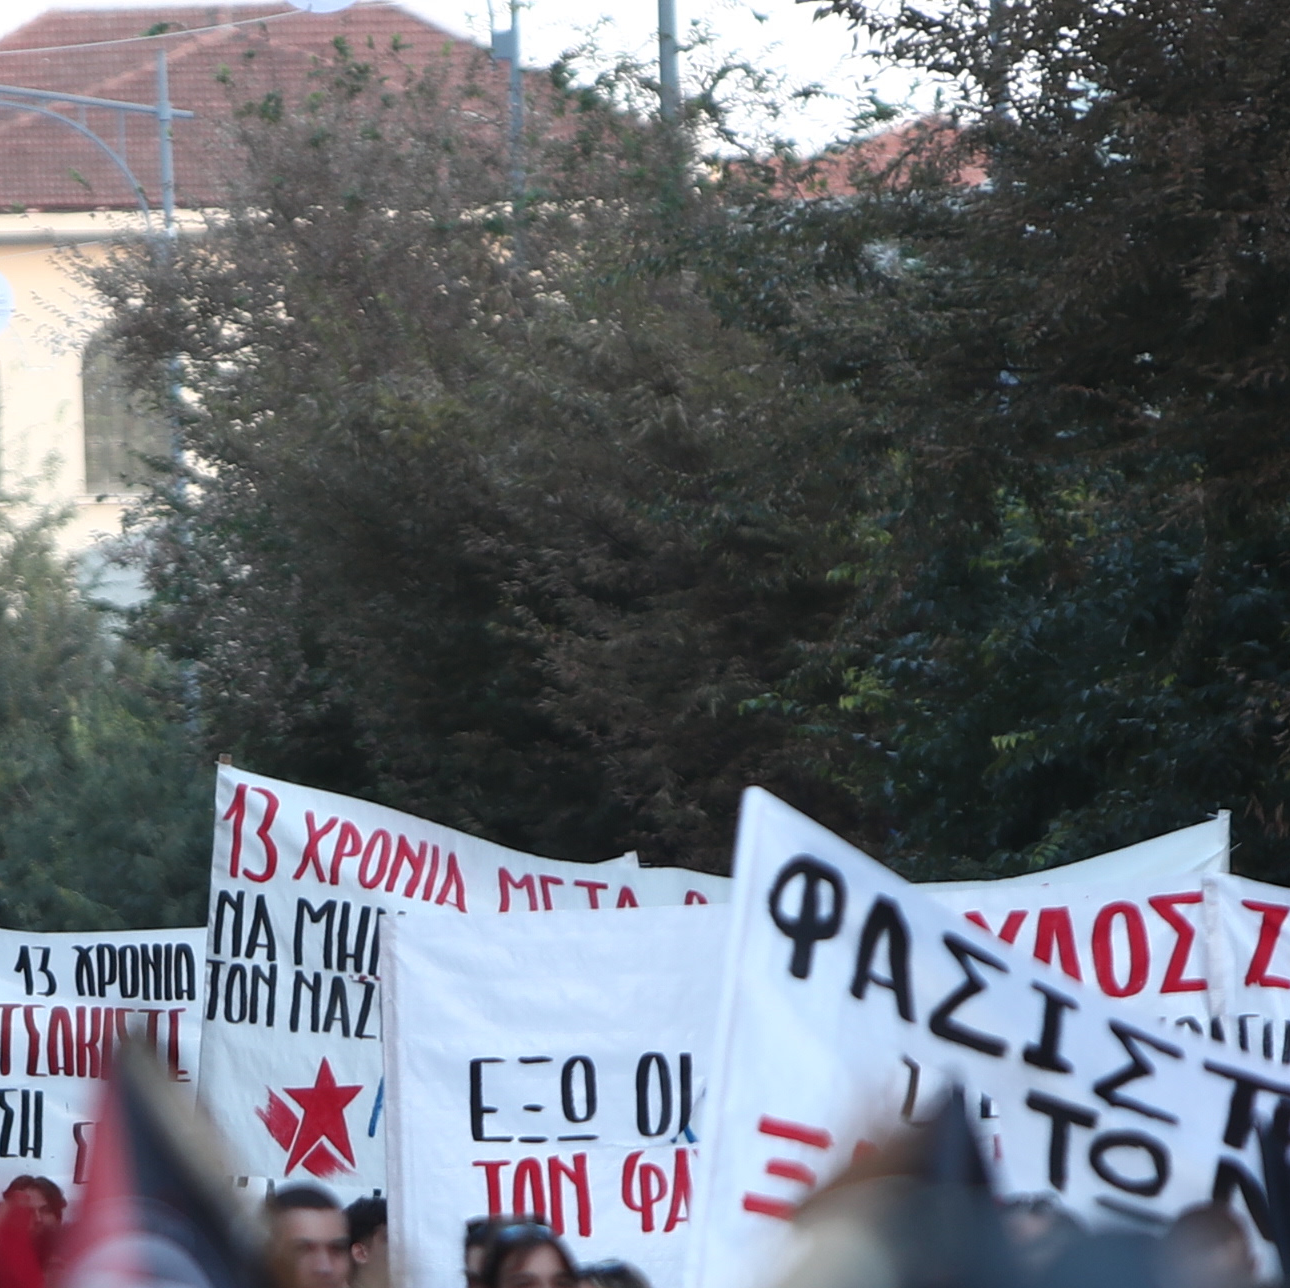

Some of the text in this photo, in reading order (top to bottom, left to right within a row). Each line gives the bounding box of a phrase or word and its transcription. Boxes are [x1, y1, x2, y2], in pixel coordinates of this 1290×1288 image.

[222, 783, 280, 883] 13
[292, 809, 469, 914] ΧΡΟΝΙΑ
[213, 889, 277, 962] ΝΑ
[13, 942, 196, 1001] 13 ΧΡΟΝΙΑ
[207, 957, 278, 1028] ΤΟΝ
[636, 1051, 692, 1138] ΟΙ
[471, 1151, 592, 1238] ΤΟΝ
